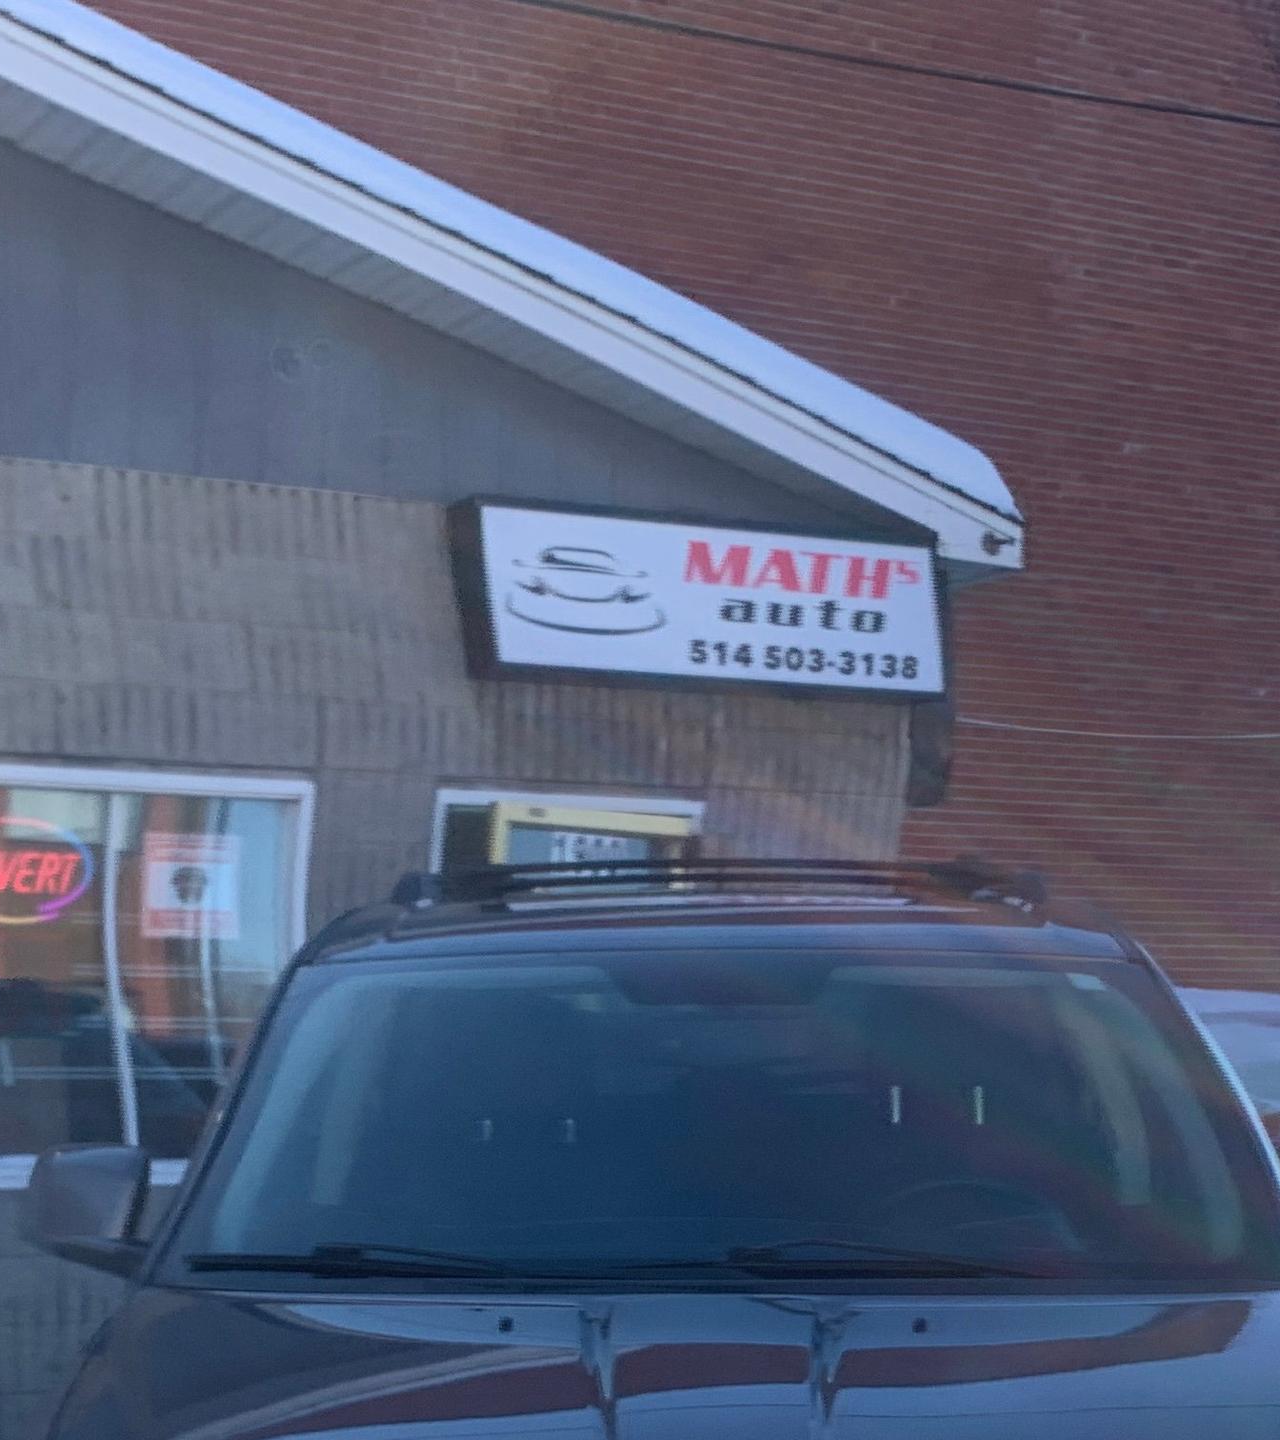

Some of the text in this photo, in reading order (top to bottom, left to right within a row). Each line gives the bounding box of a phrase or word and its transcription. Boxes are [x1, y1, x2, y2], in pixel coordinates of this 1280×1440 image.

[719, 599, 888, 634] auto
[689, 638, 919, 680] 514 503-3138
